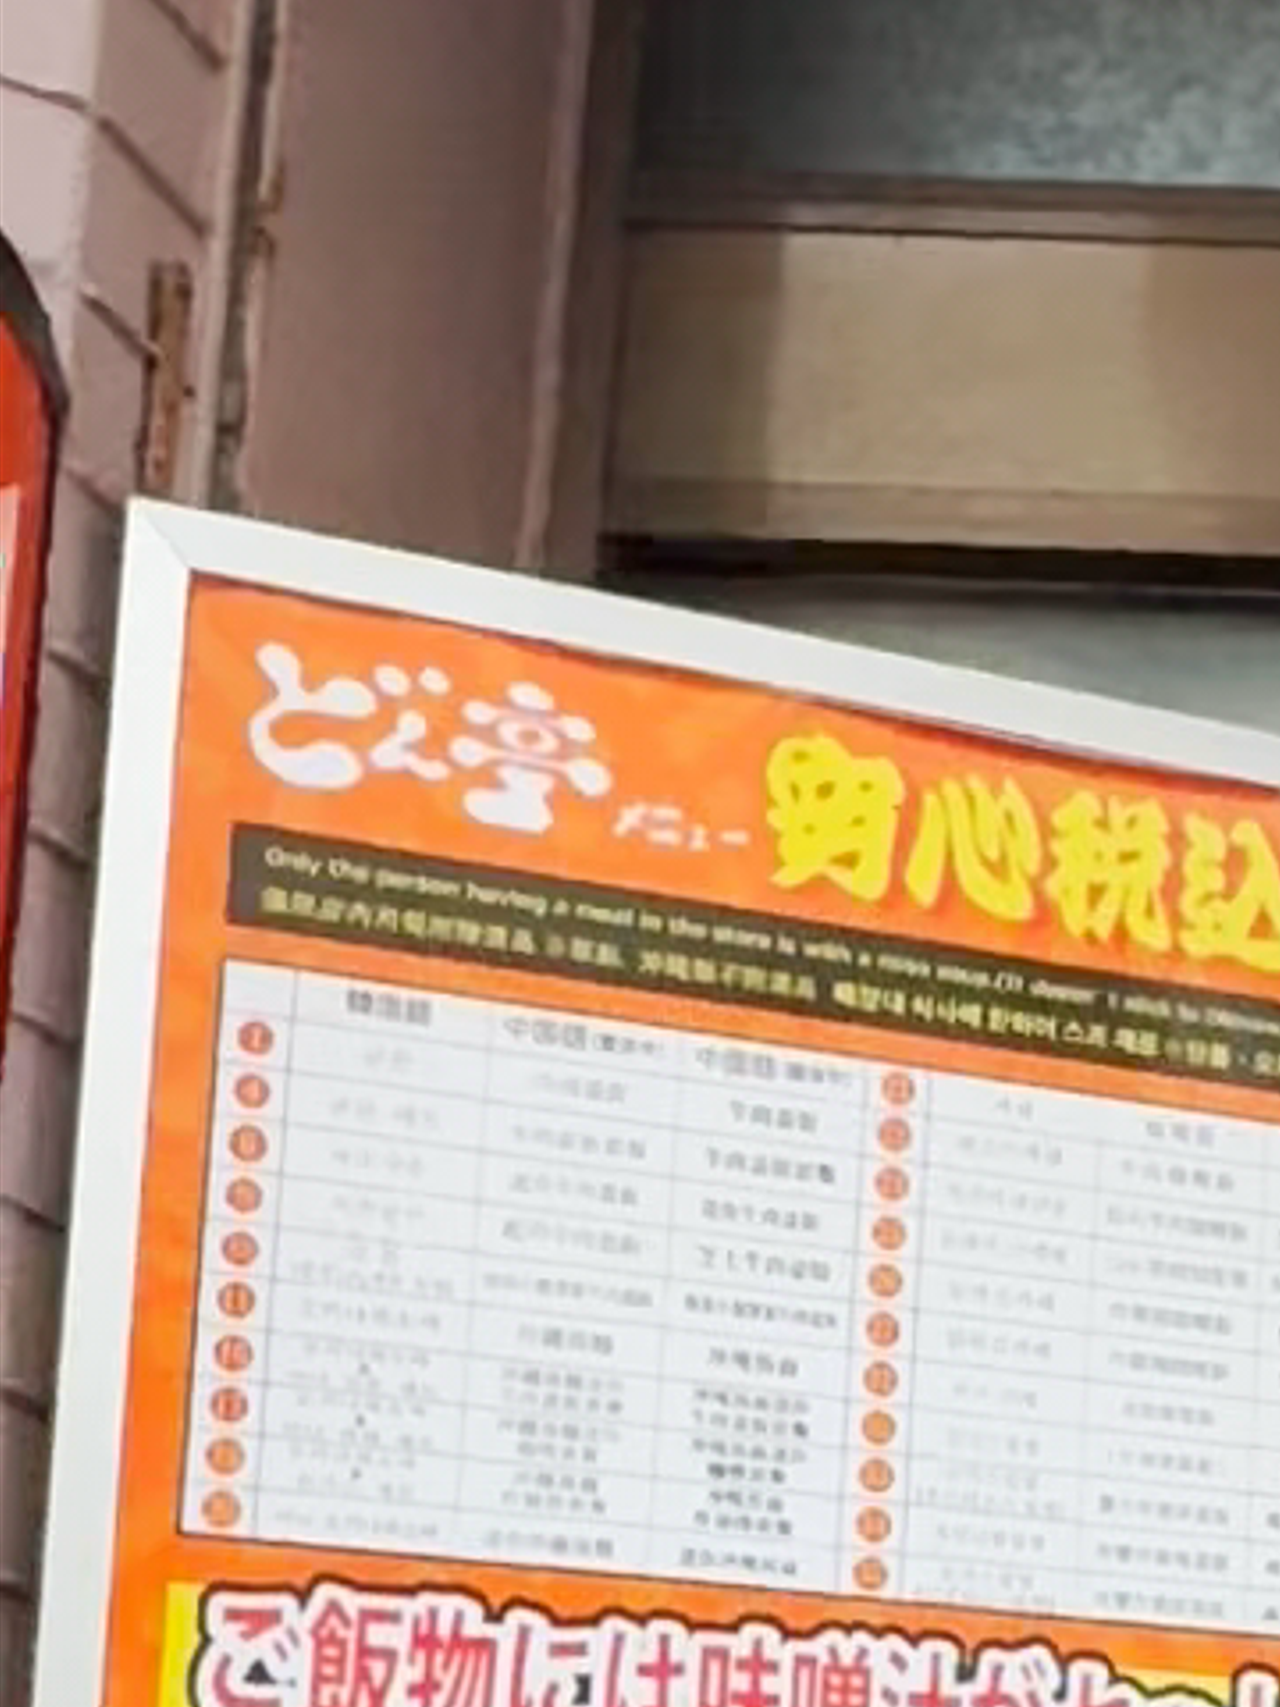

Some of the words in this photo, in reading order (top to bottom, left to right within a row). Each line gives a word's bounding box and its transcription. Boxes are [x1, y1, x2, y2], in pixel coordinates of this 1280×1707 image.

[613, 801, 748, 853] メニュー
[265, 845, 323, 876] Only
[329, 858, 370, 885] the
[374, 866, 461, 897] person
[466, 881, 547, 917] having
[552, 899, 571, 915] a
[639, 911, 662, 933] in
[668, 917, 707, 938] the
[712, 926, 771, 950] store
